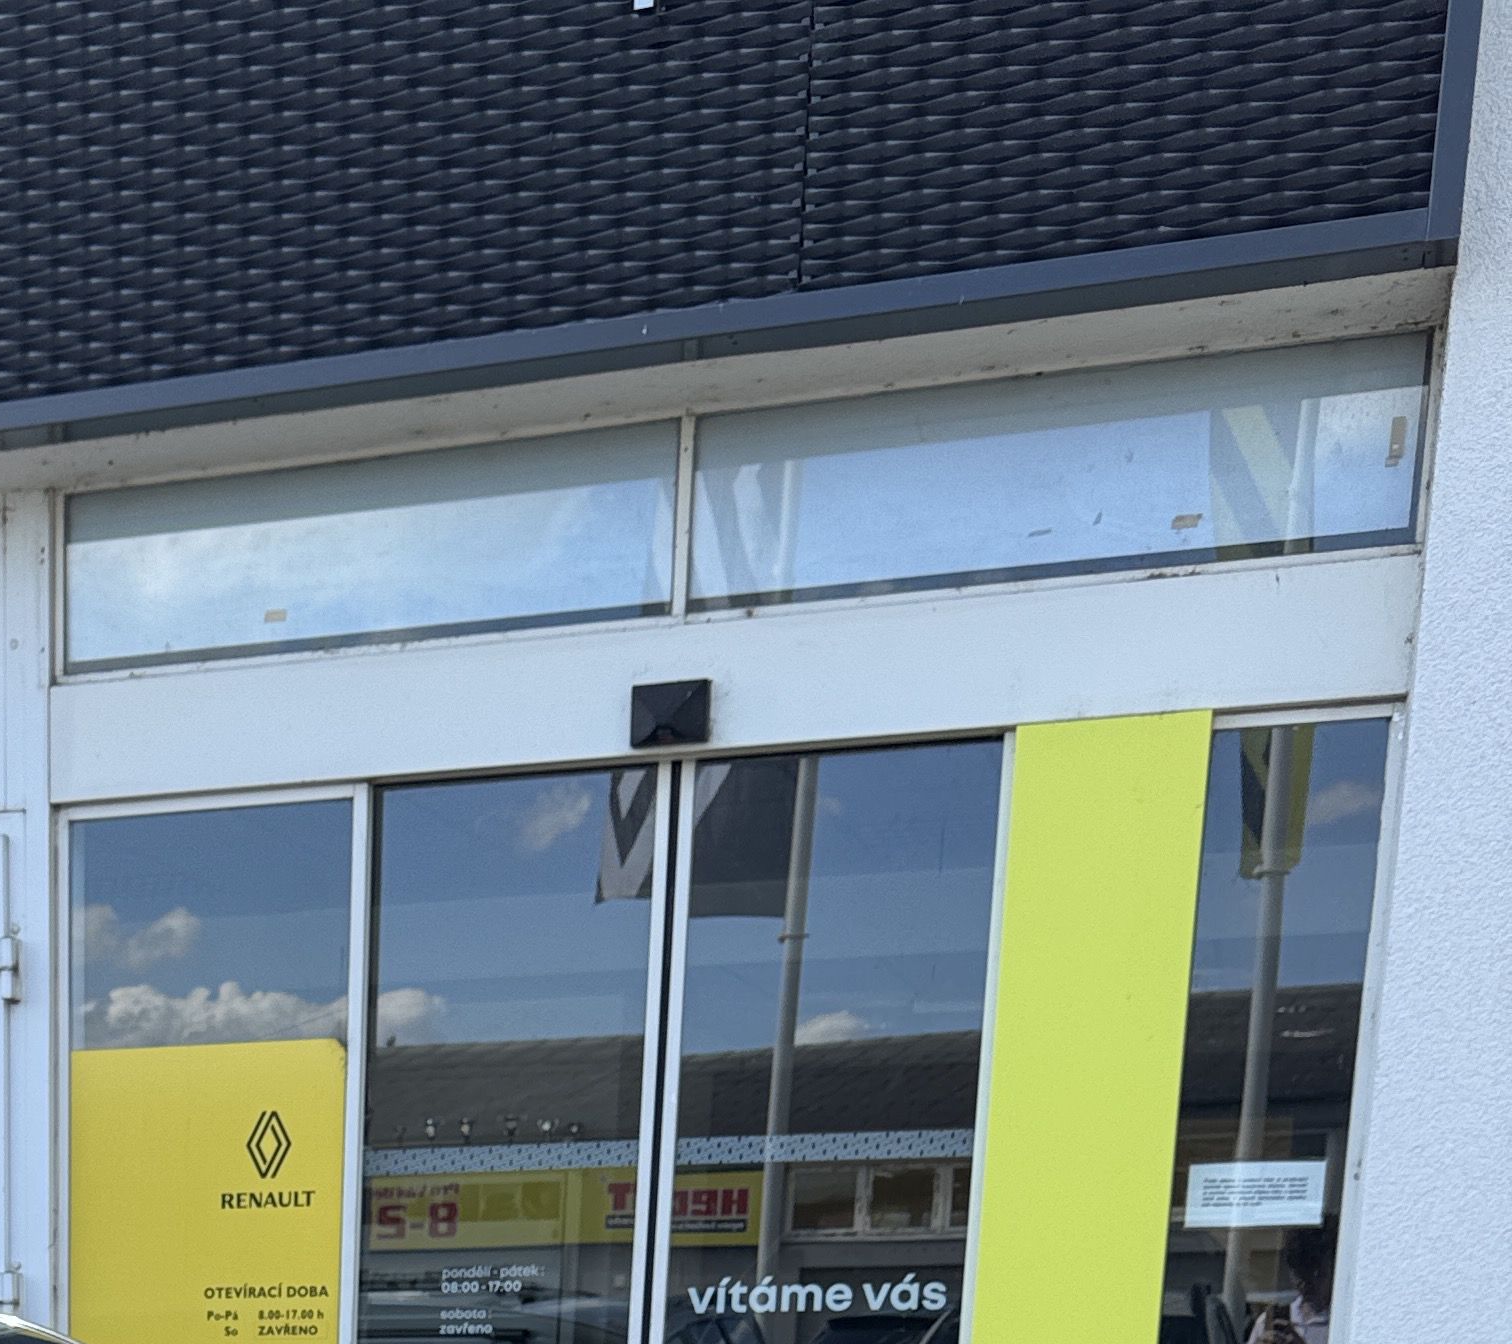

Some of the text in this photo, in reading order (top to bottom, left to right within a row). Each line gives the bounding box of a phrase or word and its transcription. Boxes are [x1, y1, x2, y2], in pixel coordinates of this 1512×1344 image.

[221, 1190, 316, 1209] RENAULT
[204, 1282, 329, 1299] OTEVÍRACÍ DOBA
[688, 1272, 947, 1314] vítáme vás
[317, 1309, 324, 1319] h
[224, 1324, 318, 1336] So ZAVŘENO
